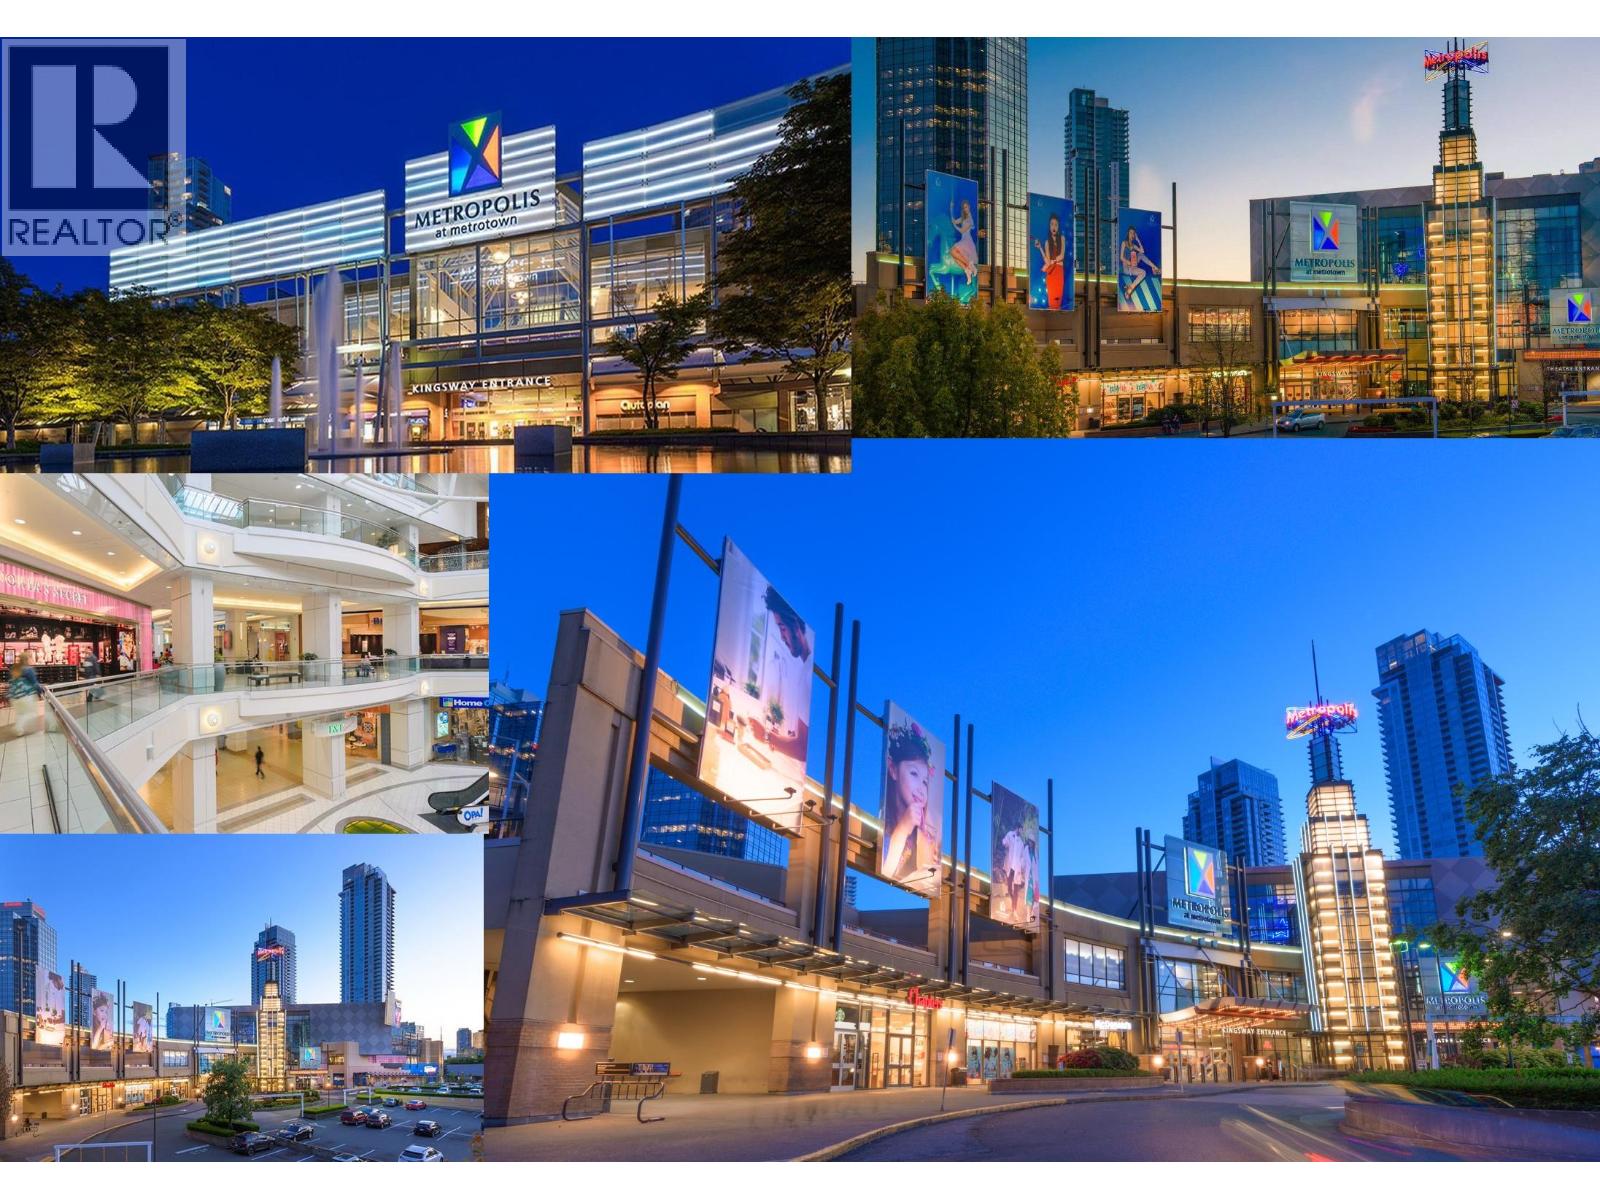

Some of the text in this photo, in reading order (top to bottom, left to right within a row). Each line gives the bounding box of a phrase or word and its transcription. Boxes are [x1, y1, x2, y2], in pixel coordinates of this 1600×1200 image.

[415, 189, 541, 229] METROPOLIS
[435, 214, 518, 238] at metrotown
[1295, 258, 1355, 268] METROPOLIS
[412, 376, 551, 394] KINGSWAY ENTRANCE
[464, 807, 483, 821] OPA!
[1172, 898, 1229, 918] METROPOLIS
[1222, 1027, 1287, 1036] KINGSWAY ENTRANCE
